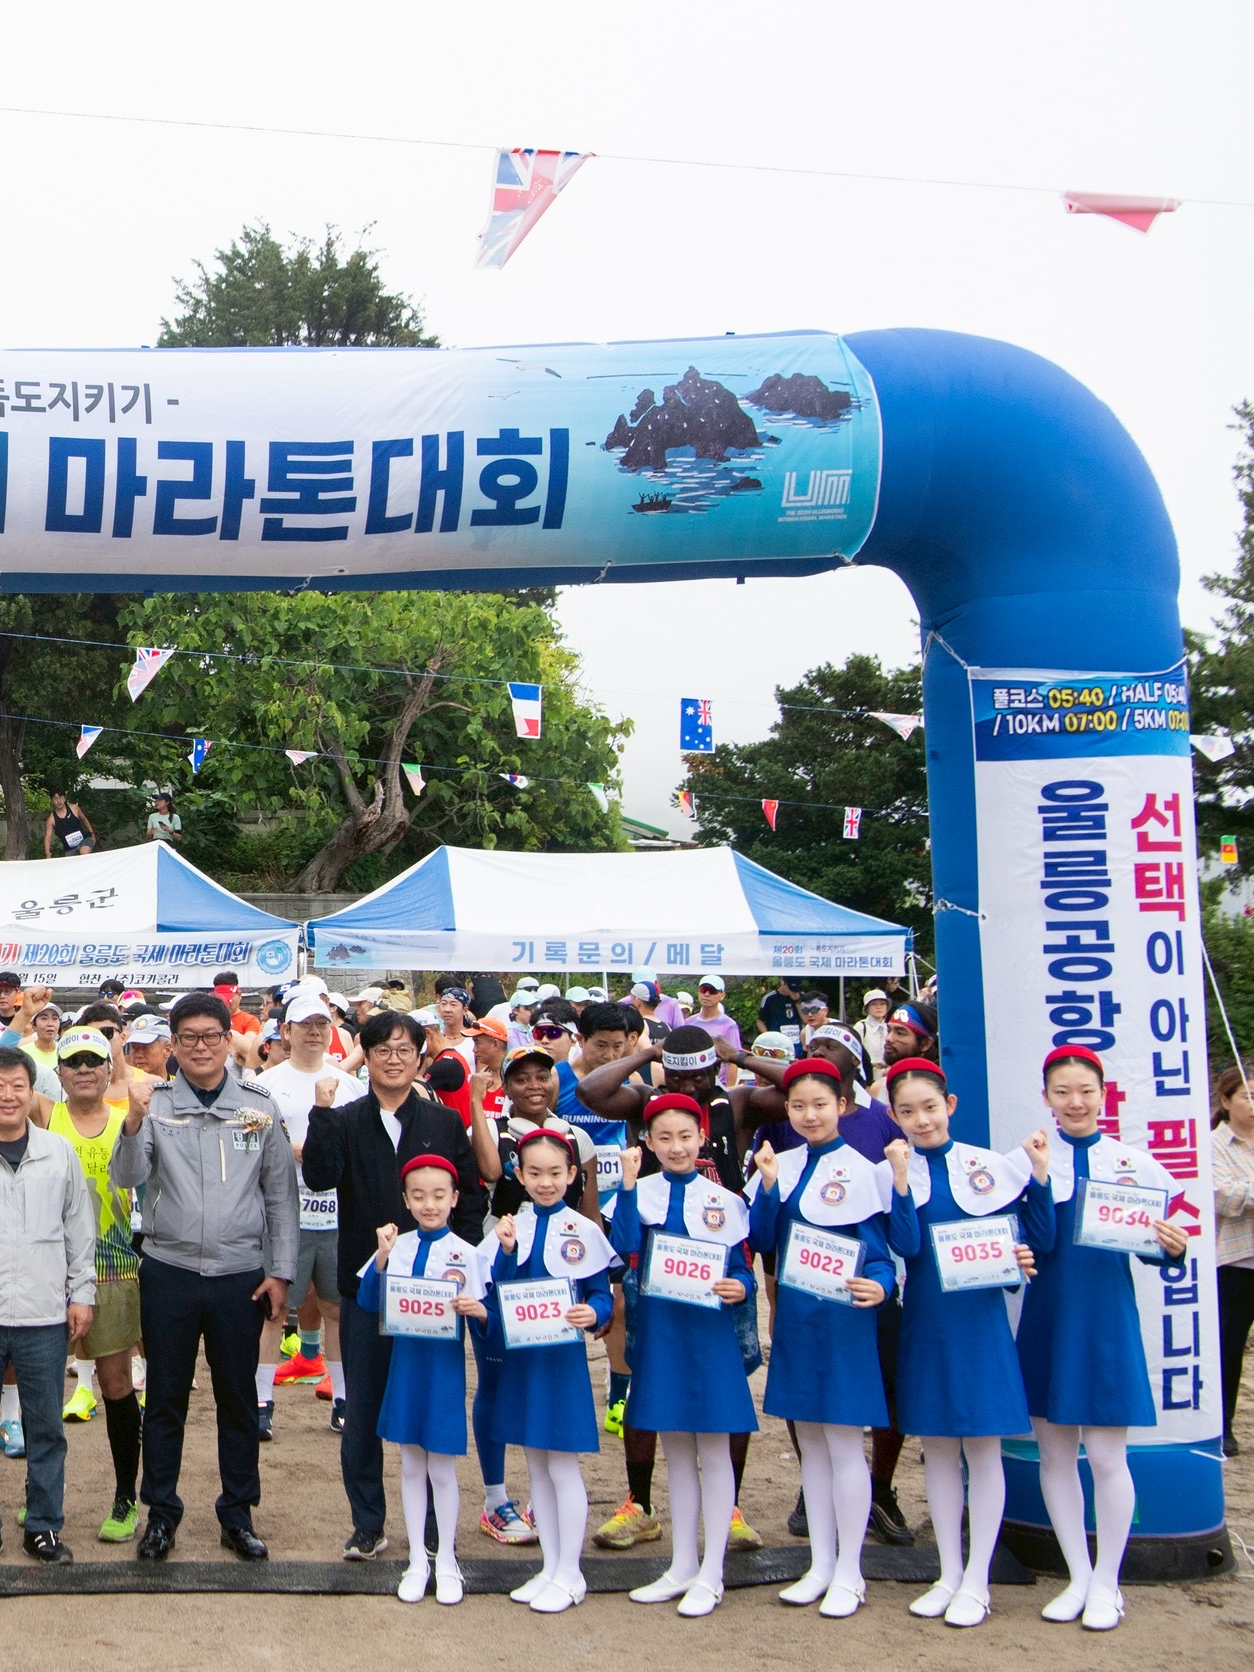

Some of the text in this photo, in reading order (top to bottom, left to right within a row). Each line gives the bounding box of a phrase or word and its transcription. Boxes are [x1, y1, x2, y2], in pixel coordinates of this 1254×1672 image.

[44, 428, 570, 541] 마라톤대회
[993, 688, 1043, 708] 풀코스
[1048, 688, 1104, 708] 05:40
[1122, 683, 1163, 703] HALF
[1006, 713, 1060, 734] 10KM
[1064, 710, 1117, 732] 07:00
[1134, 709, 1166, 729] 5KM
[12, 888, 118, 921] 울릉군
[1038, 780, 1122, 1052] 울릉공항
[22, 943, 76, 964] 제20회
[80, 944, 128, 964] 울릉도
[133, 944, 164, 964] 국제
[168, 942, 251, 964] 마라톤대회
[773, 945, 803, 954] 제20회
[772, 956, 893, 968] 울릉도 국제 마라톤대회
[33, 973, 57, 983] 15일
[79, 974, 101, 984] 협찬
[302, 1199, 336, 1213] 7068
[1099, 1206, 1150, 1228] 9034
[800, 1249, 843, 1276] 9022
[952, 1242, 1002, 1262] 9035
[664, 1258, 711, 1280] 9026
[399, 1298, 444, 1316] 9025
[515, 1301, 561, 1321] 9023
